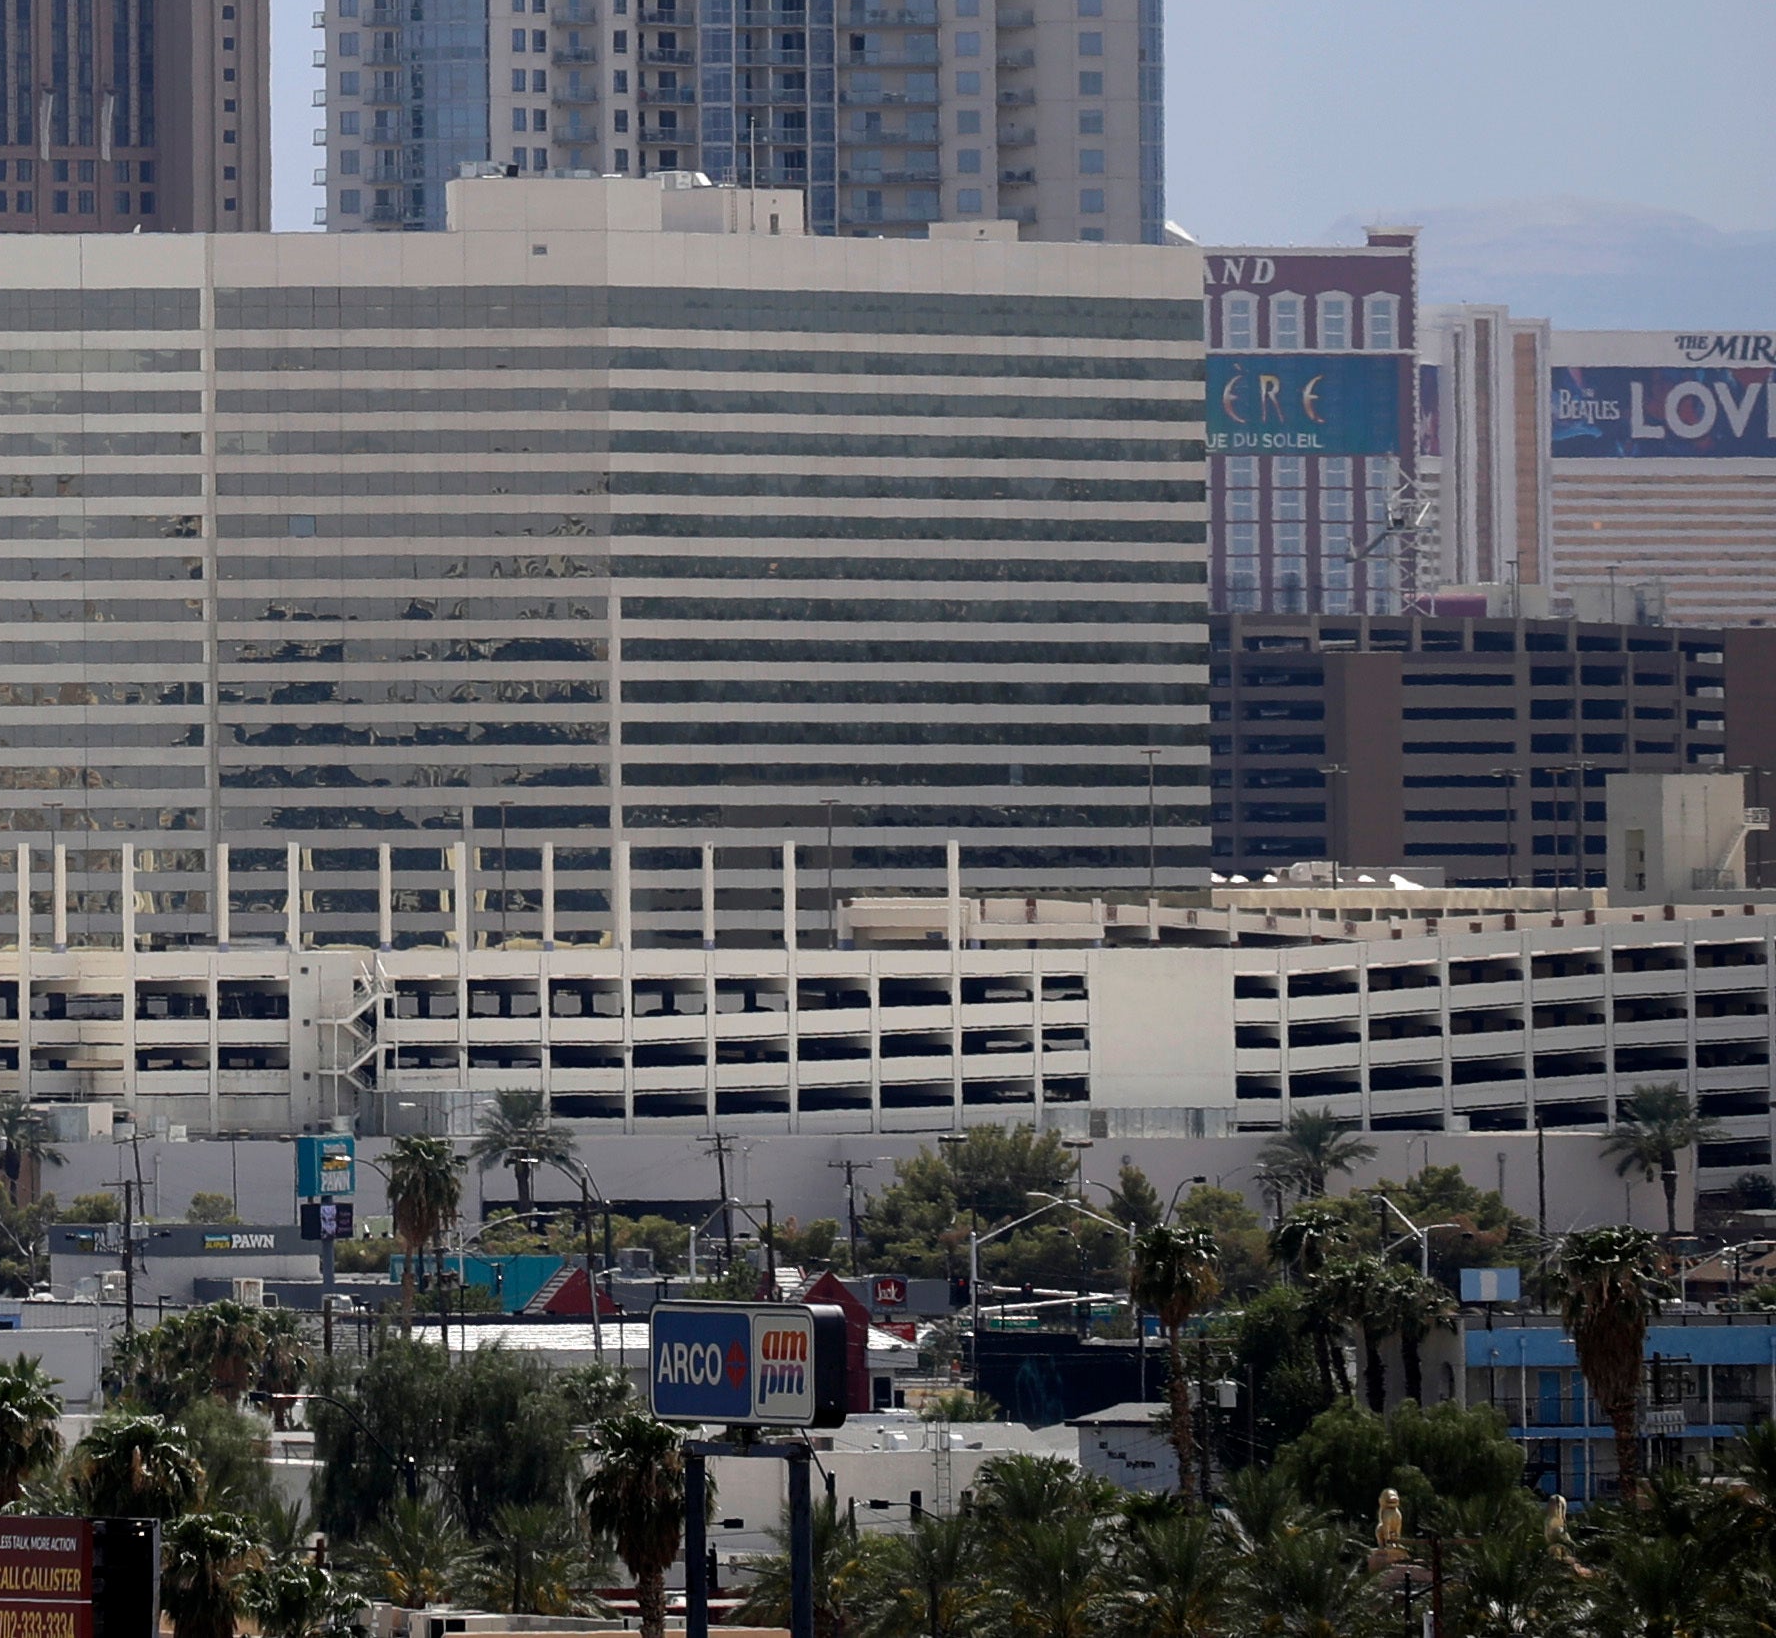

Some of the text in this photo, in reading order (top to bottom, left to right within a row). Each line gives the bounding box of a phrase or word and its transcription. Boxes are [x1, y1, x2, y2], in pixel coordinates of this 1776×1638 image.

[1675, 335, 1776, 362] THE MIR
[1233, 433, 1258, 448] DU
[1262, 433, 1324, 449] SOLEIL
[320, 1170, 350, 1191] PAWN
[231, 1234, 276, 1249] PAWN
[761, 1331, 808, 1362] am
[657, 1342, 723, 1386] ARCO
[758, 1363, 805, 1405] pm
[31, 1536, 50, 1550] MORE
[50, 1536, 77, 1552] ACTION
[22, 1566, 82, 1593] CALLISTER
